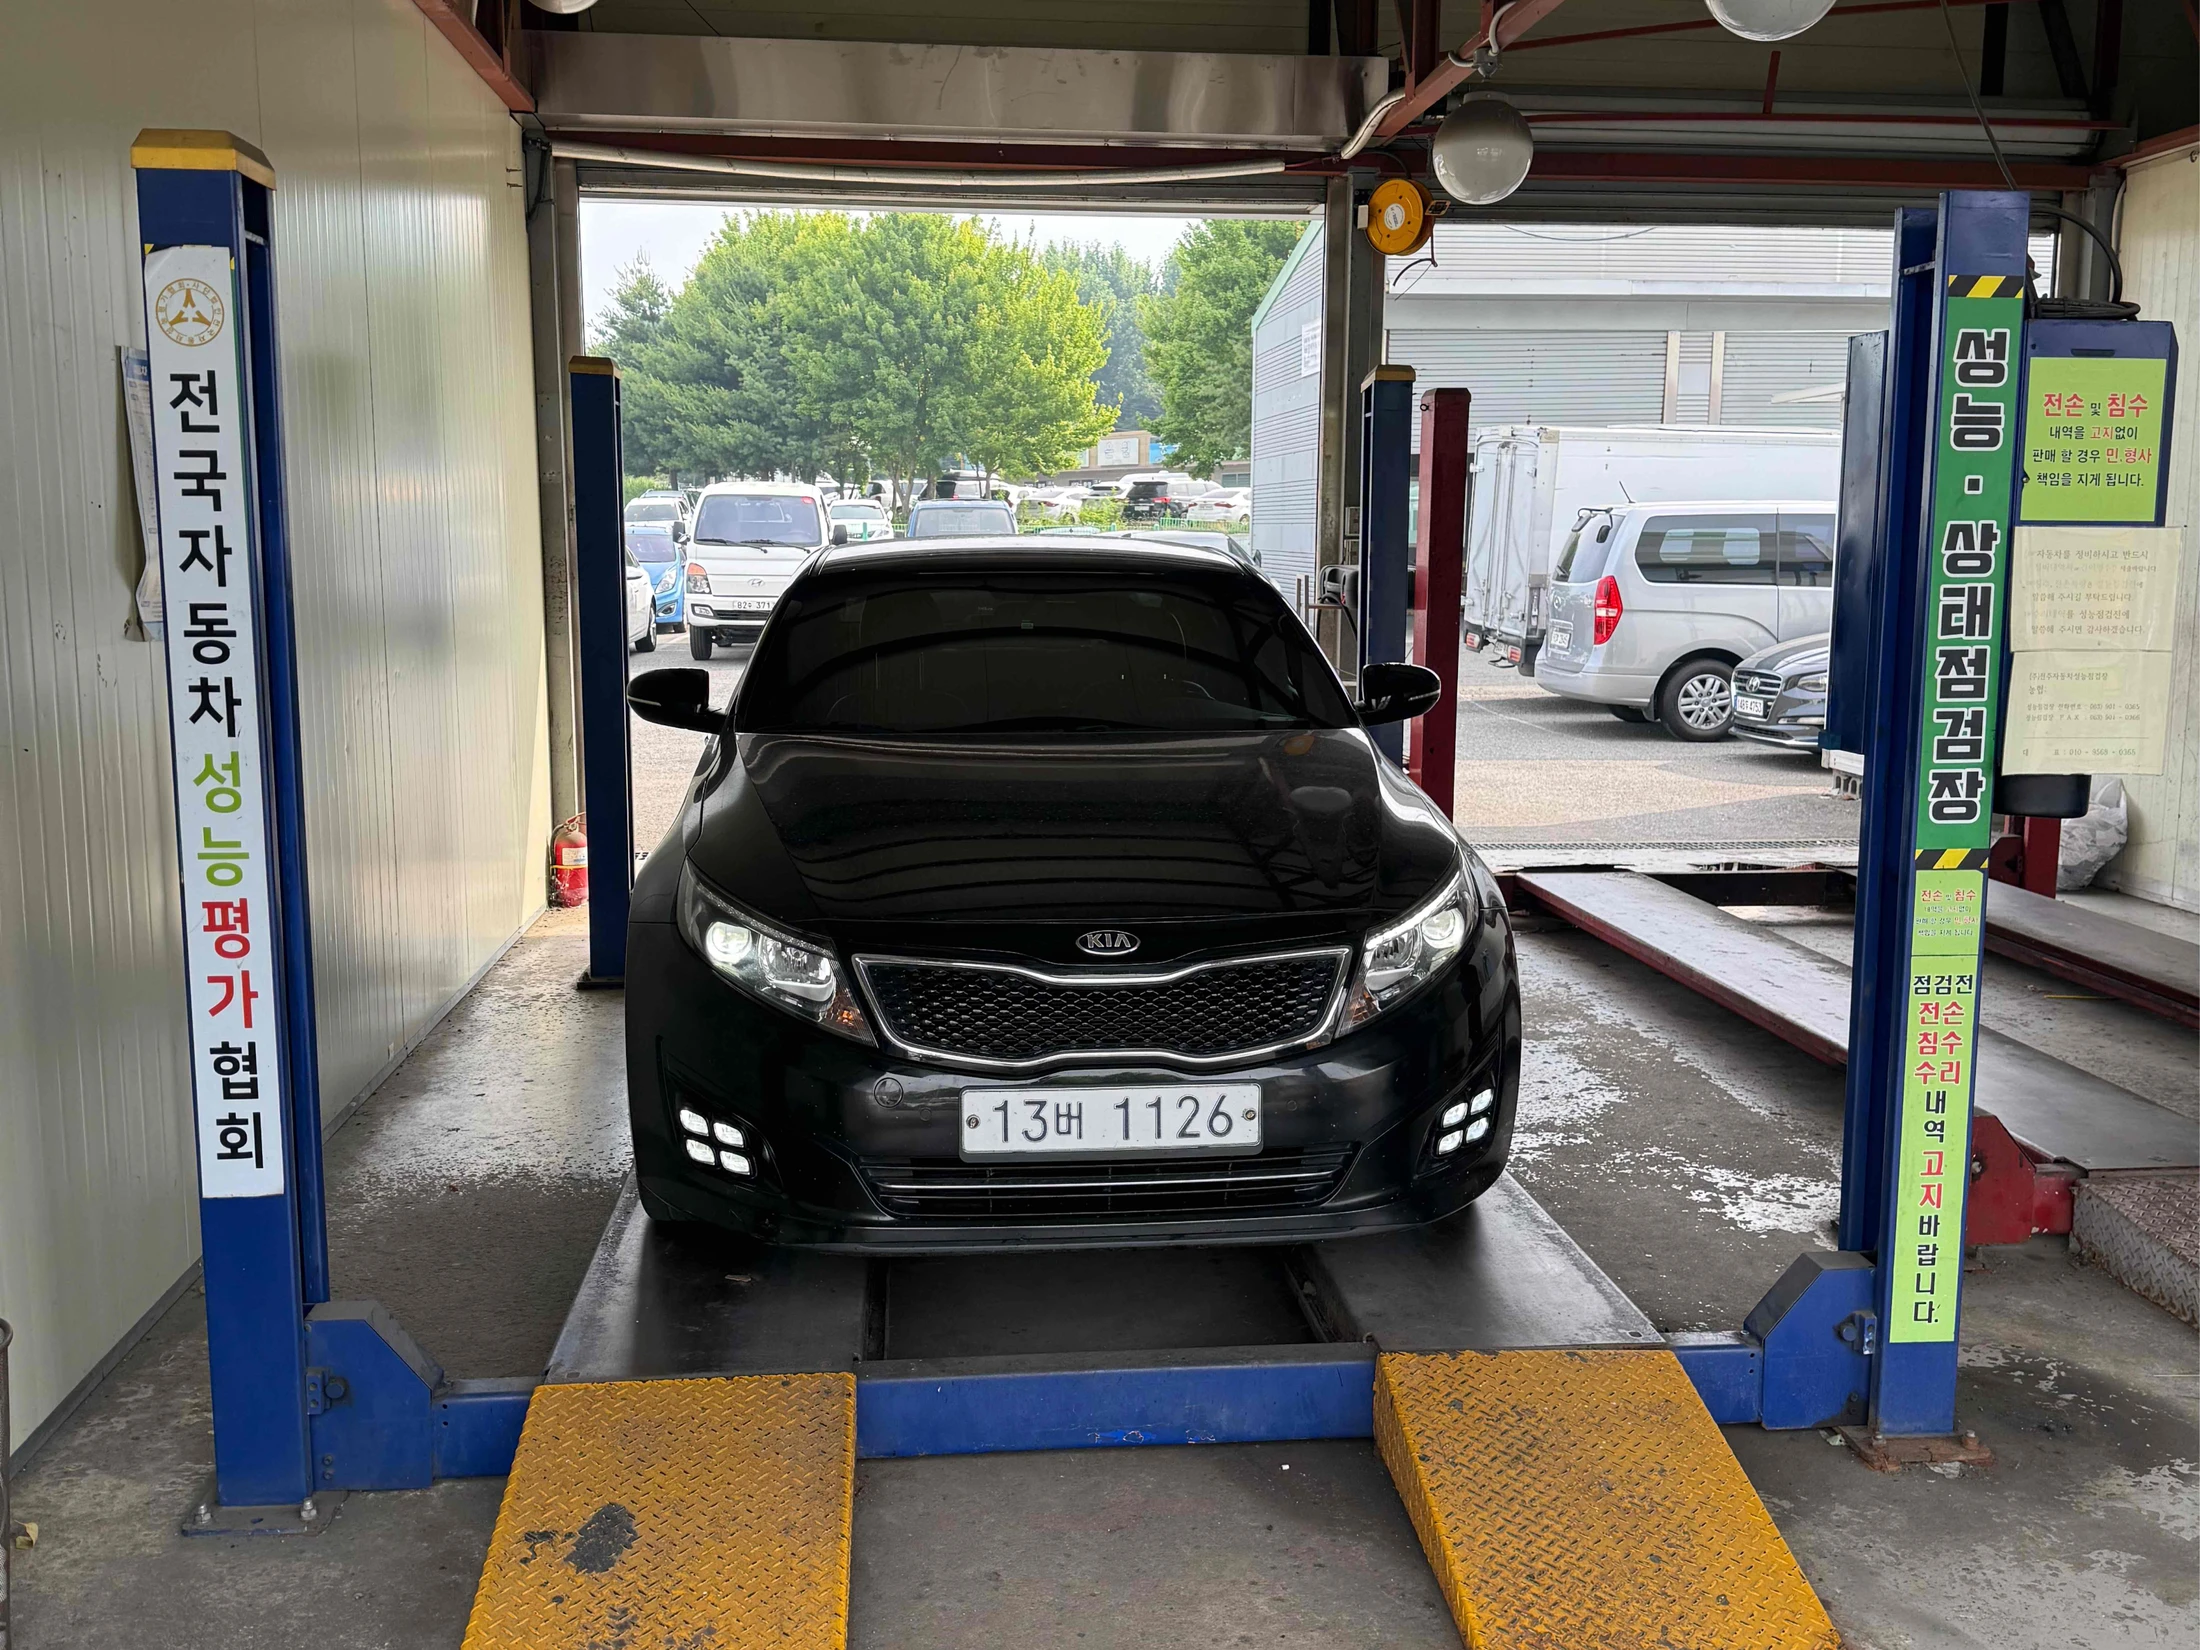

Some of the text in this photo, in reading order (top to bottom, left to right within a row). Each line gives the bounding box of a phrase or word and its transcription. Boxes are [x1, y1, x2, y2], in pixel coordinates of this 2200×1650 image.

[2043, 393, 2148, 418] 전손 및 침수
[2049, 426, 2138, 441] 내역을 고지없이
[2032, 449, 2056, 463] 판매
[2061, 449, 2073, 463] 할
[2077, 449, 2100, 463] 경우
[2036, 472, 2144, 487] 책임을 지게 됩니다.
[1921, 889, 1943, 902] 전손
[1955, 889, 1976, 902] 침수
[1087, 932, 1131, 949] KIA
[1913, 974, 1973, 995] 점검전
[1918, 1001, 1965, 1025] 전손
[1917, 1031, 1963, 1056] 침수
[1914, 1061, 1960, 1085] 수리
[992, 1094, 1234, 1143] 13버 1126
